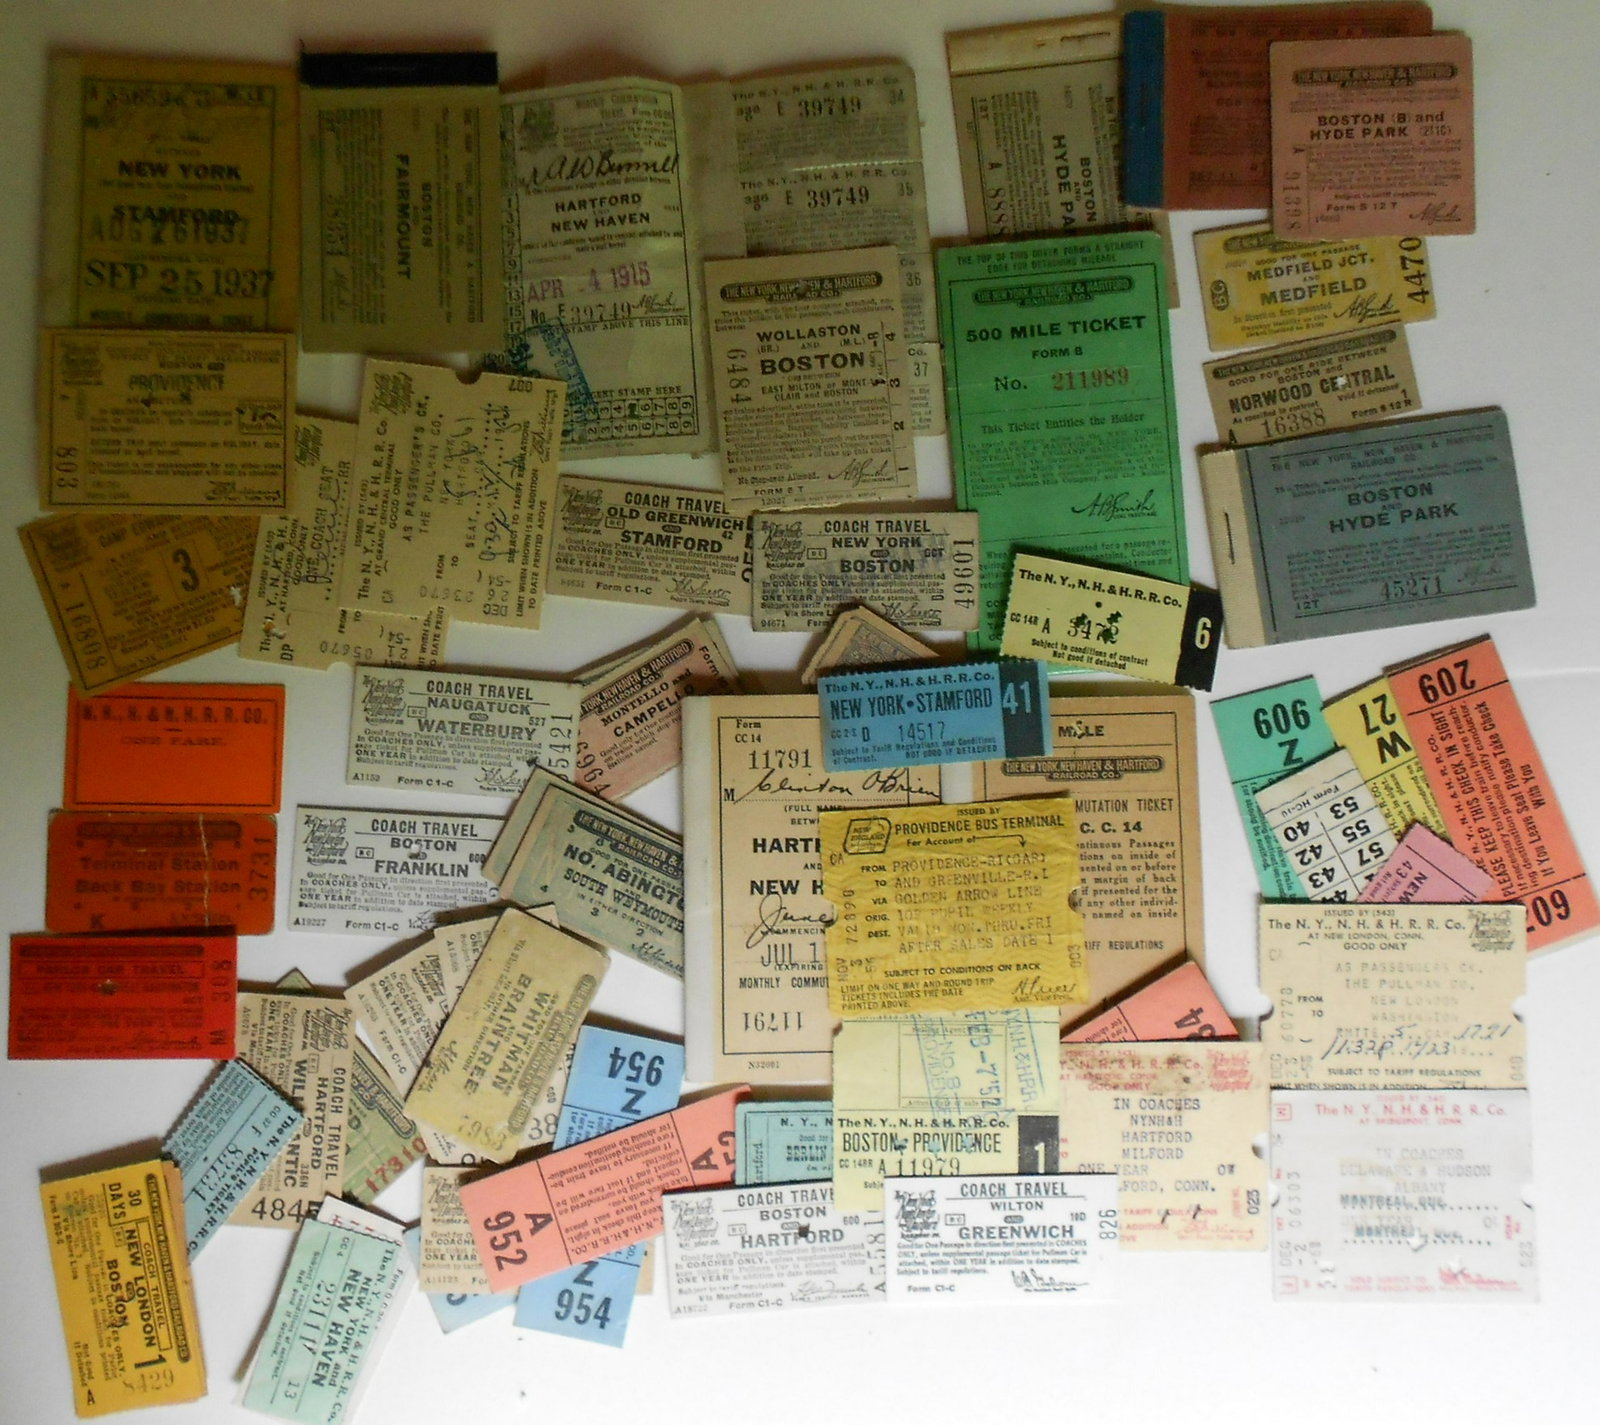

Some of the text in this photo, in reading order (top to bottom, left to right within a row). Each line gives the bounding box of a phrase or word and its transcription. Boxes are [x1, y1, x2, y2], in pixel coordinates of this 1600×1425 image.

[798, 96, 861, 118] 39749
[1318, 111, 1445, 127] BOSTON and
[1310, 125, 1407, 140] HYDE PARK
[118, 160, 241, 180] NEW YORK
[1051, 134, 1071, 194] HYDE
[807, 186, 870, 209] 39749
[1079, 156, 1097, 222] BOSTON
[555, 192, 641, 212] HARTFORD
[112, 205, 241, 225] STAMFORD
[397, 154, 410, 280] FAIRMOUNT
[421, 183, 432, 246] BOSTON
[552, 213, 650, 232] NEW HAVEN
[85, 260, 275, 298] SEP 25 1937
[1247, 253, 1374, 282] MEDFIELD JCT.
[1399, 237, 1427, 304] 4470
[528, 261, 650, 302] APR 1915
[1260, 278, 1367, 306] MEDFIELD
[640, 318, 688, 328] THIS LINE
[756, 324, 861, 343] WOLLASTON
[966, 315, 1146, 342] 500 MILE TICKET
[760, 352, 865, 376] BOSTON
[1032, 347, 1070, 359] FORM
[726, 349, 752, 404] 6484
[994, 366, 1130, 392] No. 211989
[1277, 369, 1320, 384] BOSTON
[774, 391, 800, 401] CLAIR
[1228, 383, 1312, 413] NORWOOD
[981, 413, 1145, 434] This Ticket Holder
[1261, 409, 1327, 440] 16388
[387, 468, 404, 529] GOOD ONLY
[624, 491, 729, 515] COACH TRAVEL
[1348, 482, 1433, 507] BOSTON
[535, 499, 549, 529] ABOVE
[607, 506, 745, 532] OLD GREENWICH
[1329, 502, 1459, 533] HYDE PARK
[824, 519, 931, 534] COACH TRAVEL
[620, 531, 723, 553] STAMFORD
[831, 535, 921, 548] NEW YORK
[172, 548, 199, 592] 3
[434, 553, 446, 579] FROM
[840, 559, 915, 574] BOSTON
[952, 538, 976, 609] 49601
[1195, 618, 1211, 649] 6
[280, 643, 295, 661] DP
[650, 641, 690, 672] HARTFORD
[1070, 644, 1148, 666] conditions contract
[427, 680, 533, 701] COACH TRAVEL
[1419, 659, 1477, 704] 209
[427, 697, 531, 716] NAUGATUCK
[600, 679, 670, 728] MONTELLO
[830, 688, 993, 720] NEW YORK STAMFORD
[1003, 681, 1031, 716] 41
[1359, 693, 1398, 736] 27
[417, 718, 537, 741] WATERBURY
[898, 722, 946, 742] 14517
[748, 749, 811, 769] 11791
[1376, 731, 1413, 765] W
[1138, 799, 1174, 811] TICKET
[1328, 796, 1361, 820] 53
[1429, 707, 1517, 897] PLEASE KEEP THIS CHECK SIGHT
[371, 819, 478, 838] COACH TRAVEL
[894, 815, 1064, 835] PROVIDENCE BUS TERMINAL
[1123, 821, 1142, 832] 14
[1283, 820, 1311, 842] 40
[1342, 819, 1372, 844] 55
[390, 837, 457, 853] BOSTON
[562, 843, 599, 869] NO.
[1129, 840, 1175, 850] Passages
[1357, 841, 1385, 867] 57
[374, 860, 470, 878] FRANKLIN
[1308, 866, 1337, 889] 43
[750, 880, 800, 895] NEW
[1093, 886, 1140, 898] presented
[562, 867, 688, 934] SOUTH WEYMOUTH
[761, 943, 796, 967] JUL
[1344, 942, 1407, 950] GOOD ONLY
[940, 966, 994, 974] CONDITIONS
[739, 977, 780, 989] MONTHLY
[462, 971, 532, 1095] BRAINTREE
[489, 988, 550, 1092] WHITMAN
[608, 1046, 665, 1087] 954
[1139, 1098, 1200, 1110] COACHES
[1316, 1104, 1338, 1116] The
[274, 1112, 296, 1137] The
[309, 1076, 328, 1169] HARTFORD
[323, 1066, 344, 1180] COACH TRAVEL
[1131, 1116, 1183, 1126] NYNH&H
[842, 1132, 1001, 1153] BOSTON PROVIDENCE
[1122, 1131, 1192, 1144] HARTFORD
[1122, 1148, 1184, 1160] MILFORD
[1437, 1165, 1491, 1177] HUDSON
[106, 1181, 128, 1220] DAYS
[126, 1188, 143, 1208] 30
[203, 1179, 232, 1216] TICKET
[737, 1192, 781, 1206] COACH
[960, 1181, 1068, 1198] COACH TRAVEL
[759, 1206, 827, 1222] BOSTON
[990, 1200, 1044, 1211] WILTON
[523, 1205, 555, 1236] A
[1098, 1208, 1118, 1241] 826
[480, 1208, 529, 1272] 952
[740, 1228, 845, 1249] HARTFORD
[958, 1225, 1074, 1240] GREENWICH
[122, 1227, 159, 1348] NEW LONDON
[907, 1285, 932, 1293] Form
[554, 1288, 613, 1330] 954
[728, 1301, 753, 1310] Form
[309, 1267, 363, 1388] NEW HAVEN
[326, 1275, 373, 1388] NEW YORK and
[282, 1379, 300, 1400] 13
